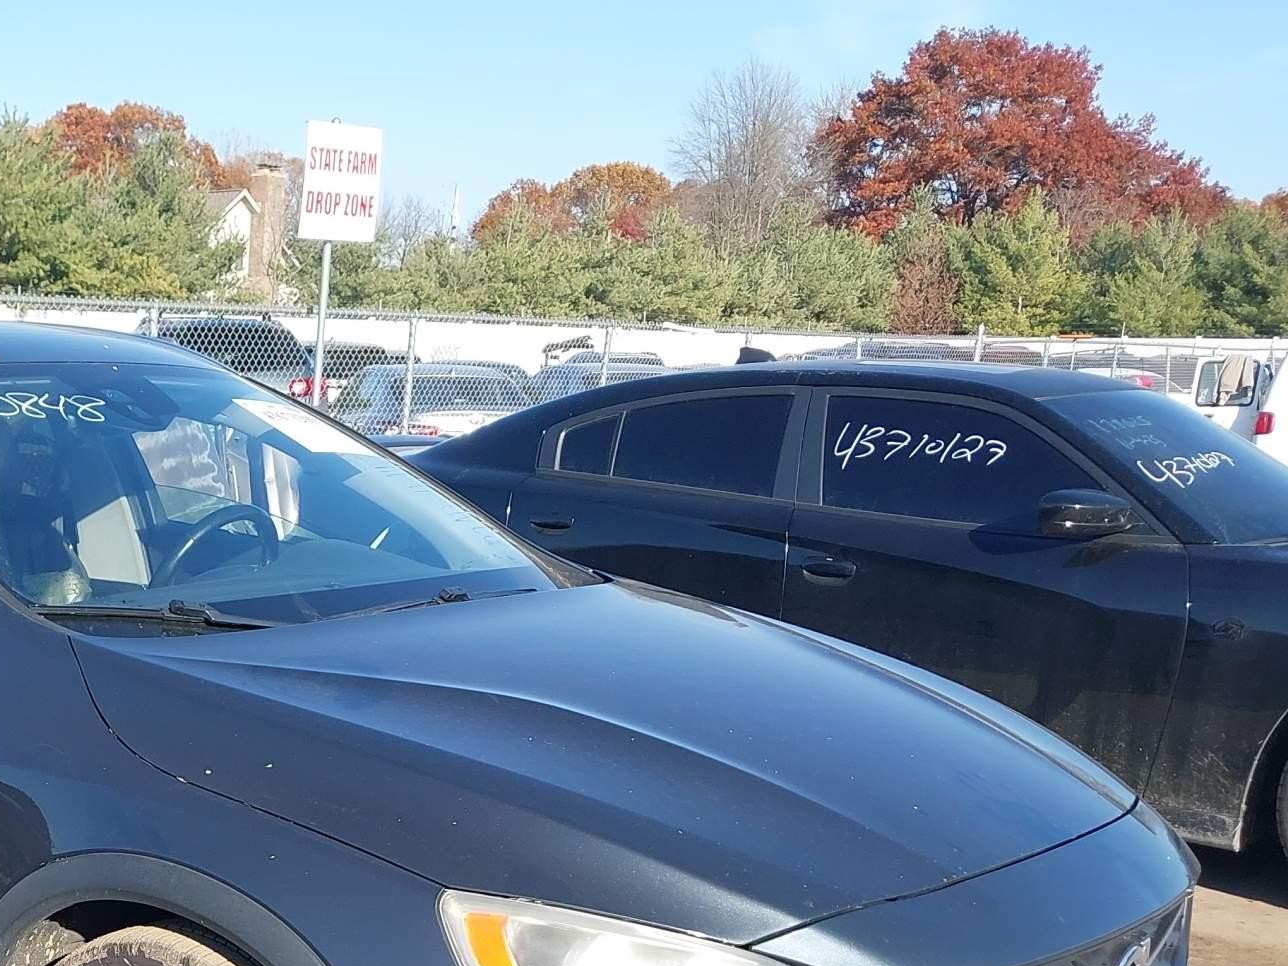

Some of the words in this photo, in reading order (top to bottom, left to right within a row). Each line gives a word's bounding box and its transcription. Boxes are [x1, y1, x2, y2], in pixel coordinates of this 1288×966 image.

[310, 146, 344, 173] STATE
[347, 150, 377, 175] FARM
[305, 190, 341, 216] DROP
[344, 193, 374, 218] ZONE
[834, 421, 1008, 470] 43710127
